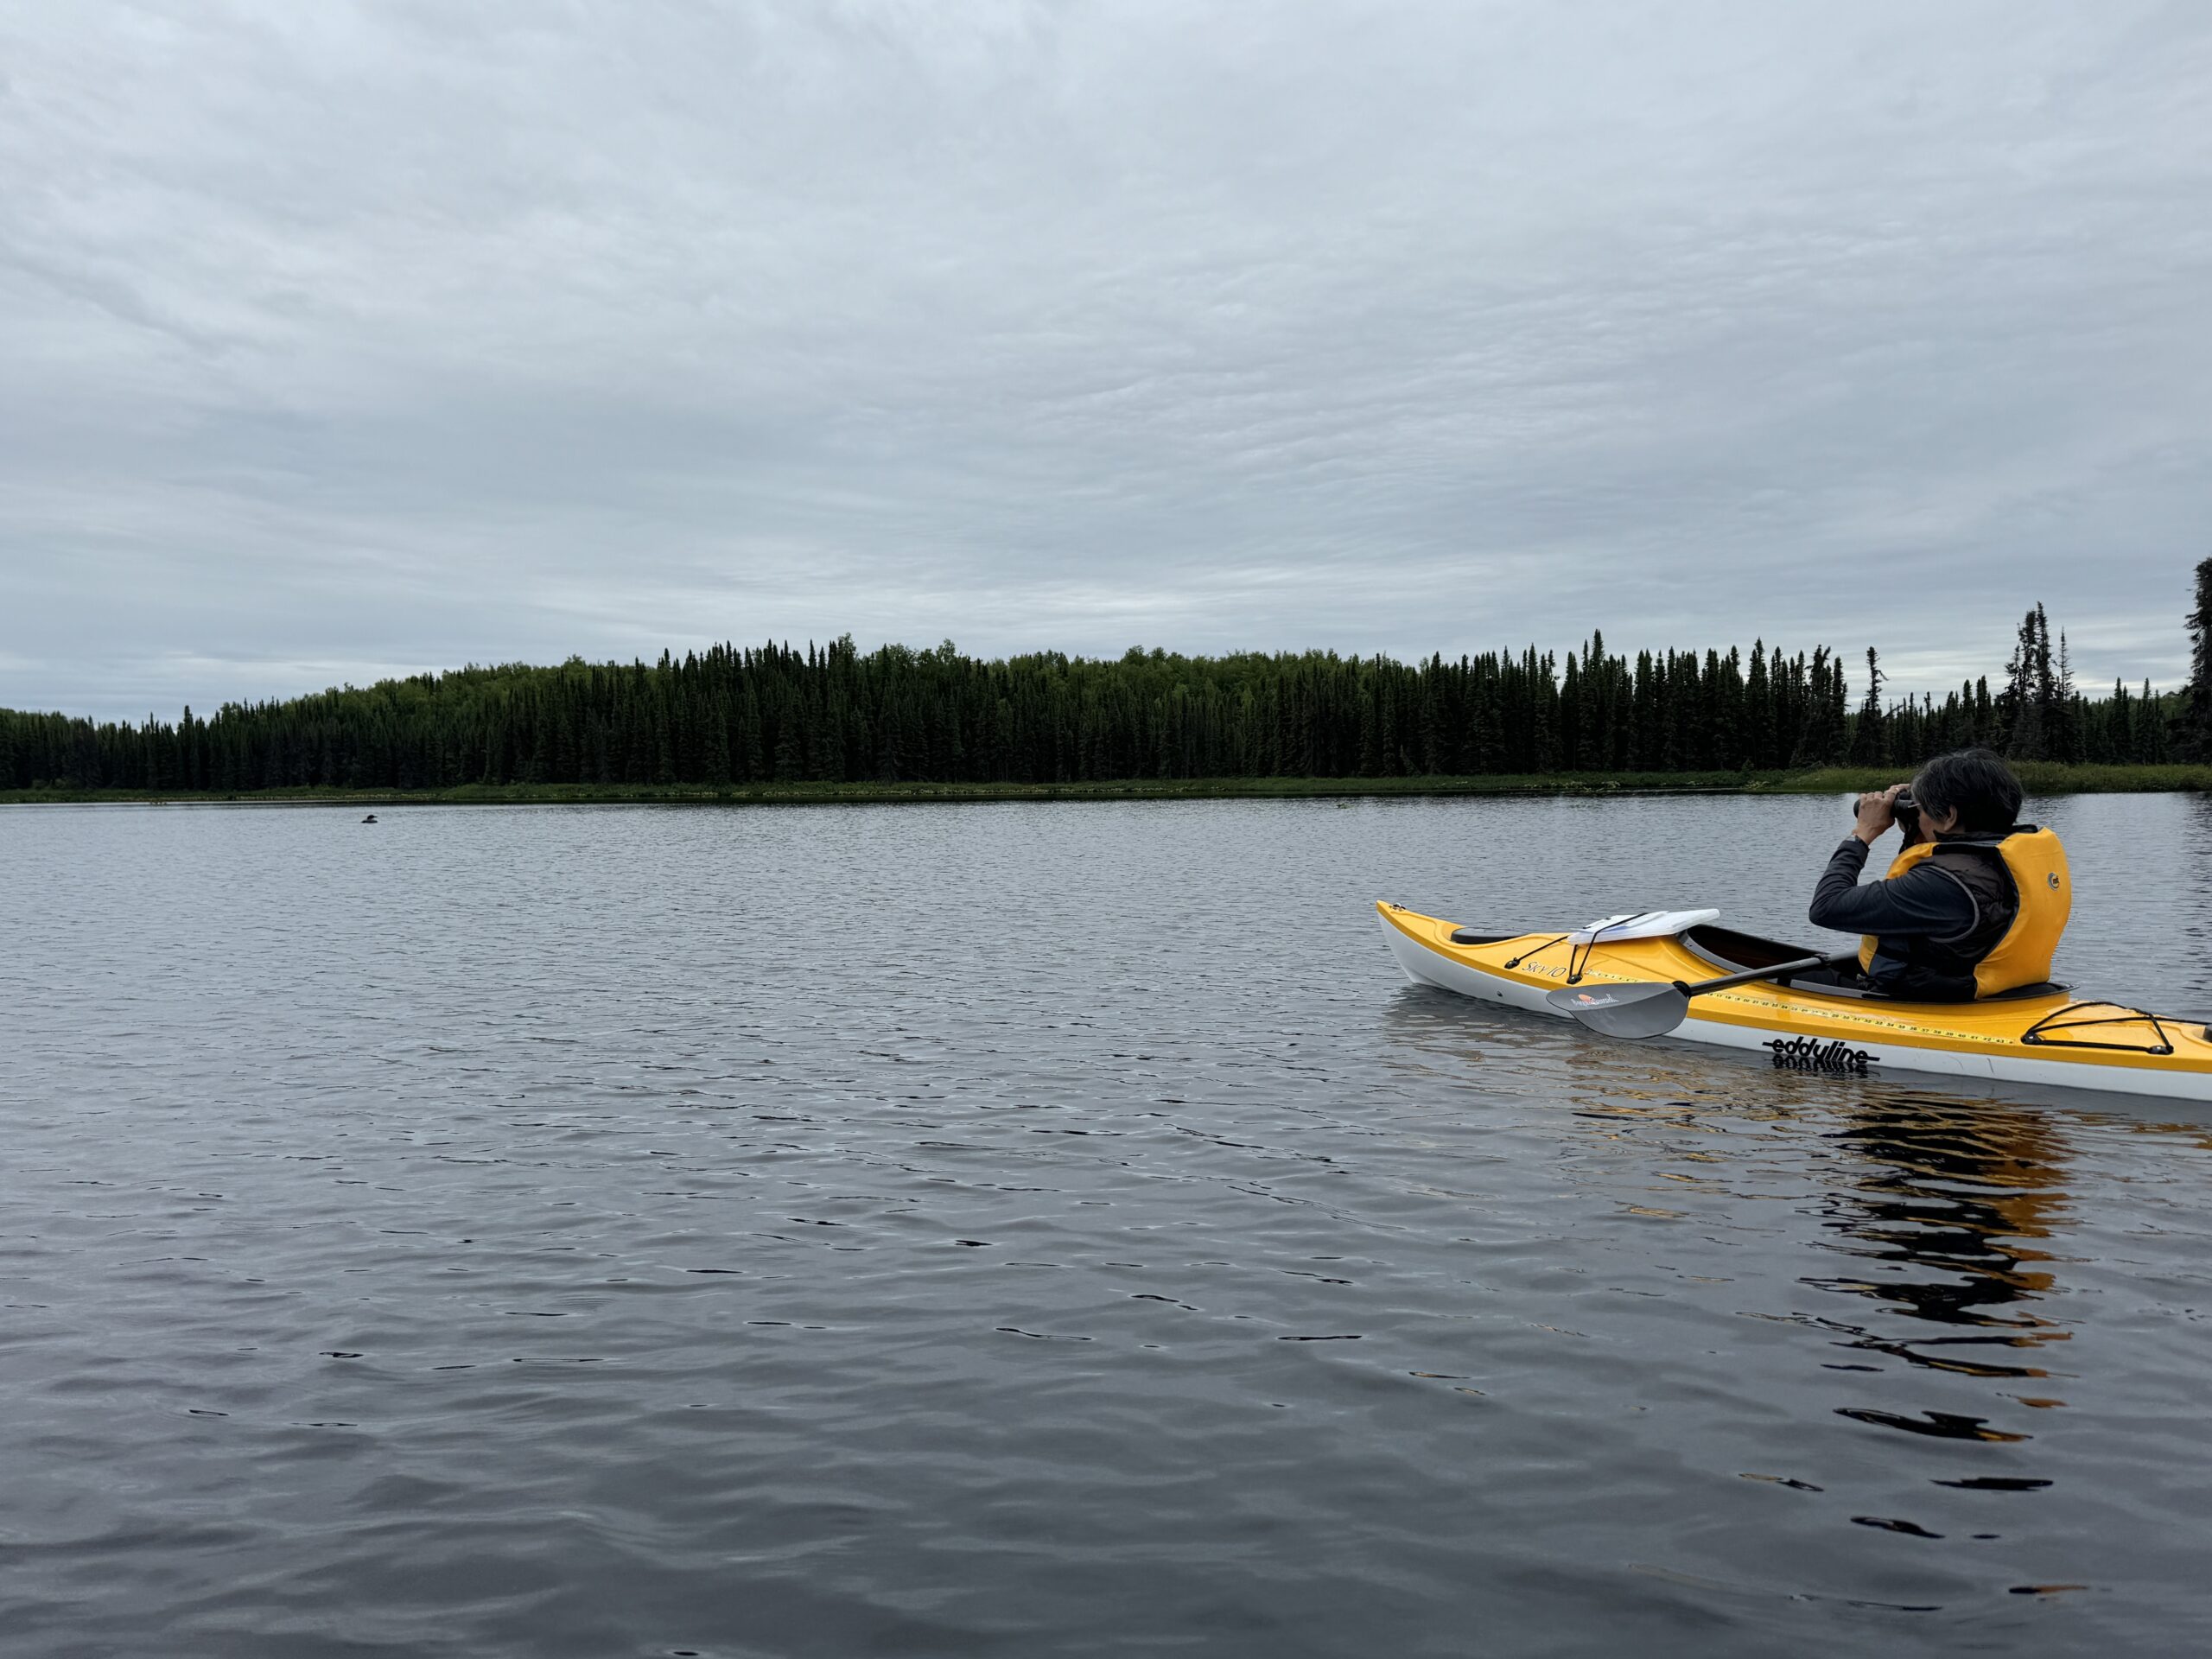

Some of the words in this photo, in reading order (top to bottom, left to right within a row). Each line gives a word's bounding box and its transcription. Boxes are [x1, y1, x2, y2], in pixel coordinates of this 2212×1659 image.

[1522, 961, 1548, 975] SKY
[1547, 966, 1567, 978] 10
[1768, 1035, 1872, 1065] eddyline
